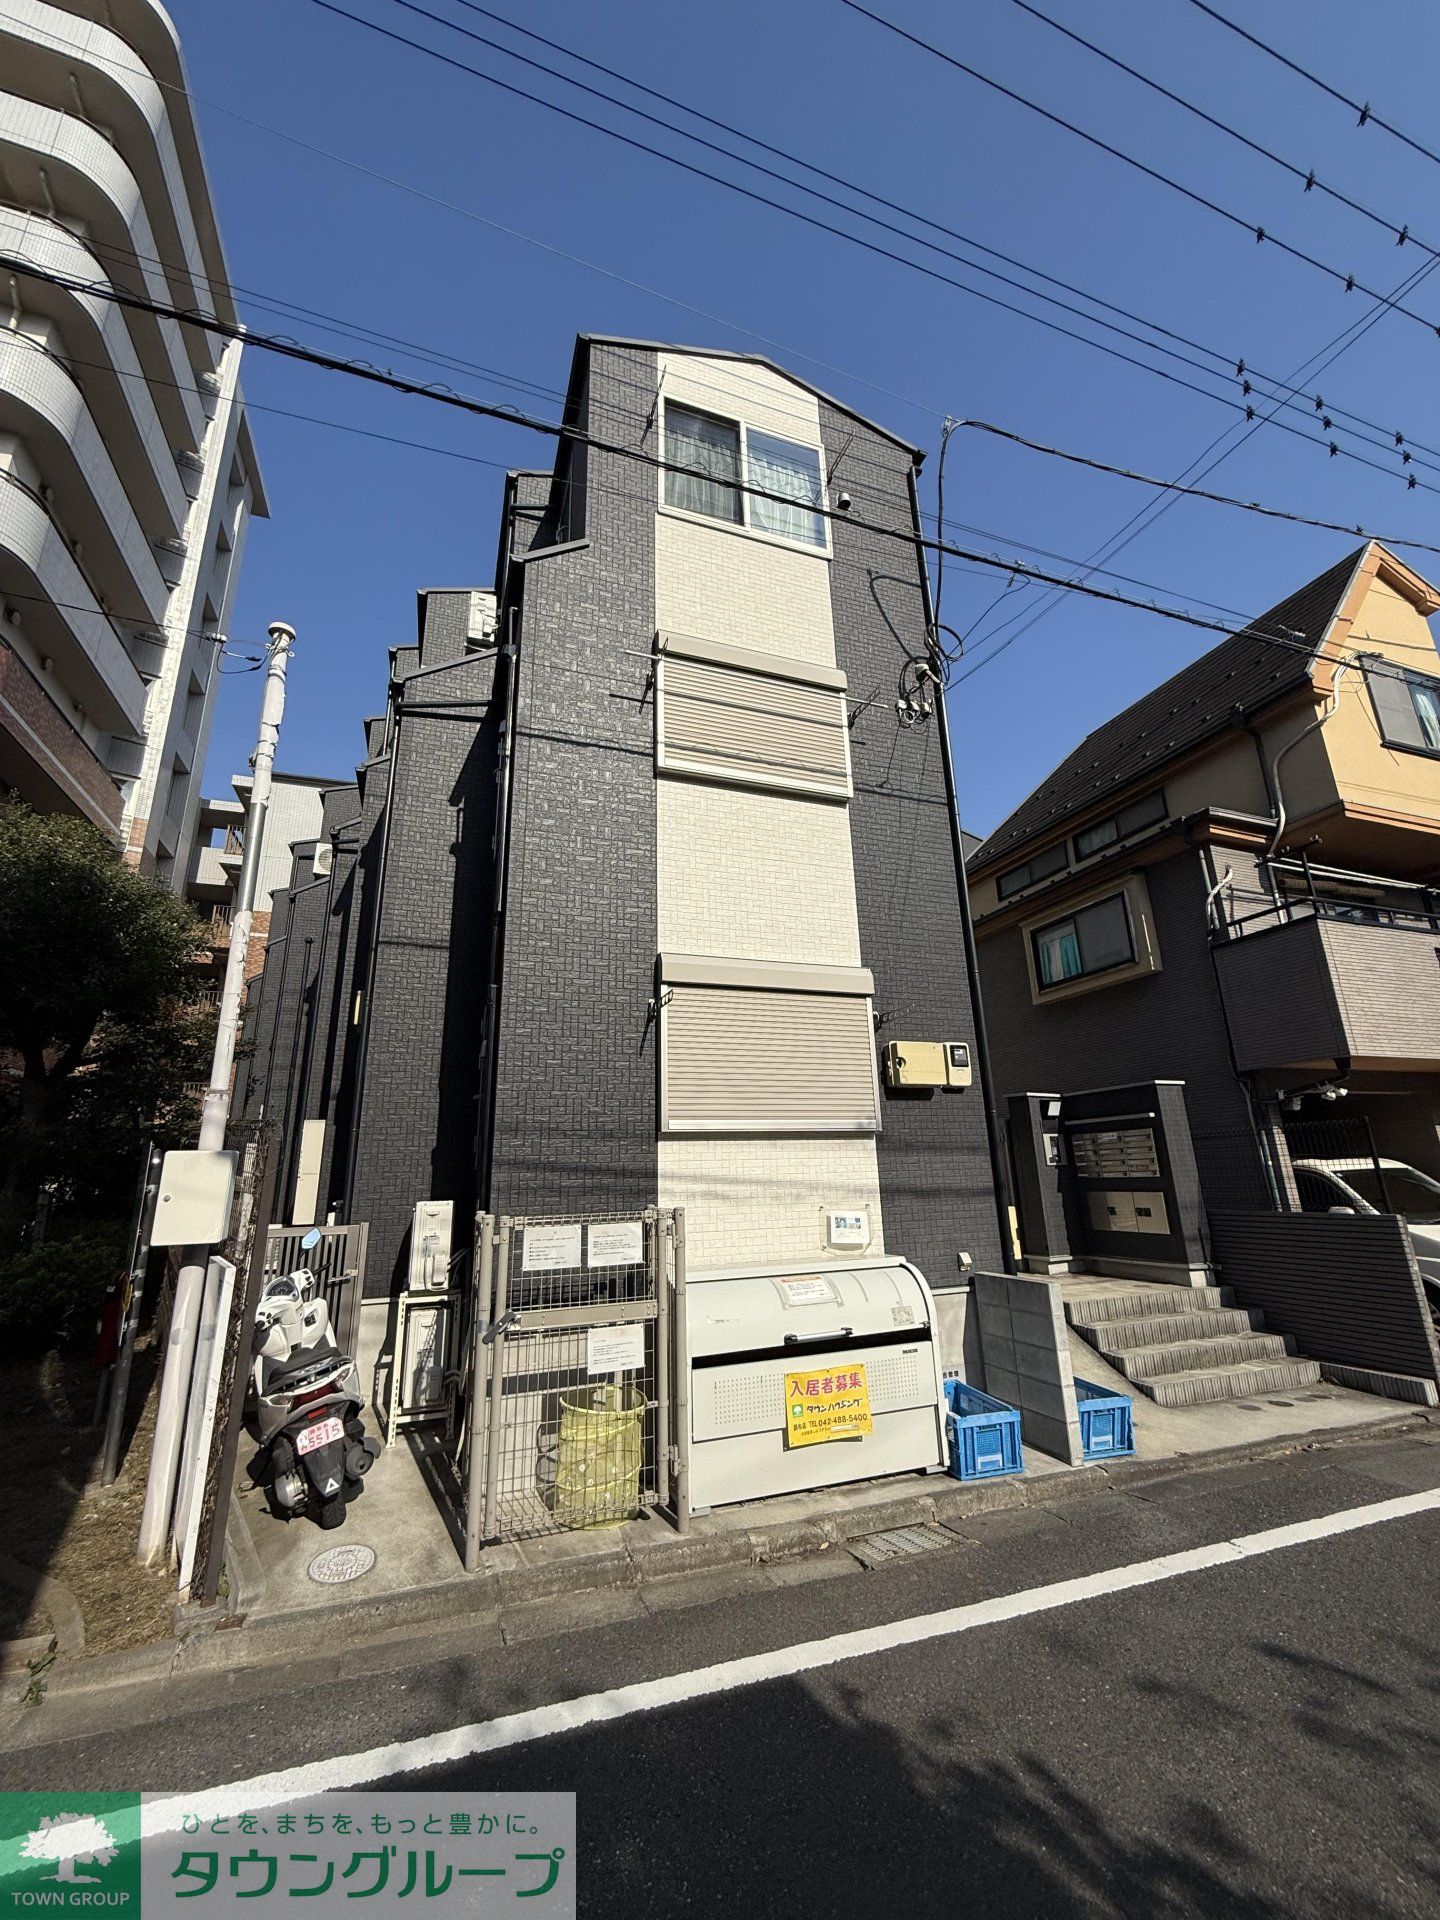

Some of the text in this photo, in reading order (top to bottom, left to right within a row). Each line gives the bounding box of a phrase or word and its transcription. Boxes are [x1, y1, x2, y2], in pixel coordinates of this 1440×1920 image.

[791, 1372, 862, 1397] 入居者募集
[807, 1398, 863, 1413] タウンハウジング
[809, 1420, 817, 1428] TEL
